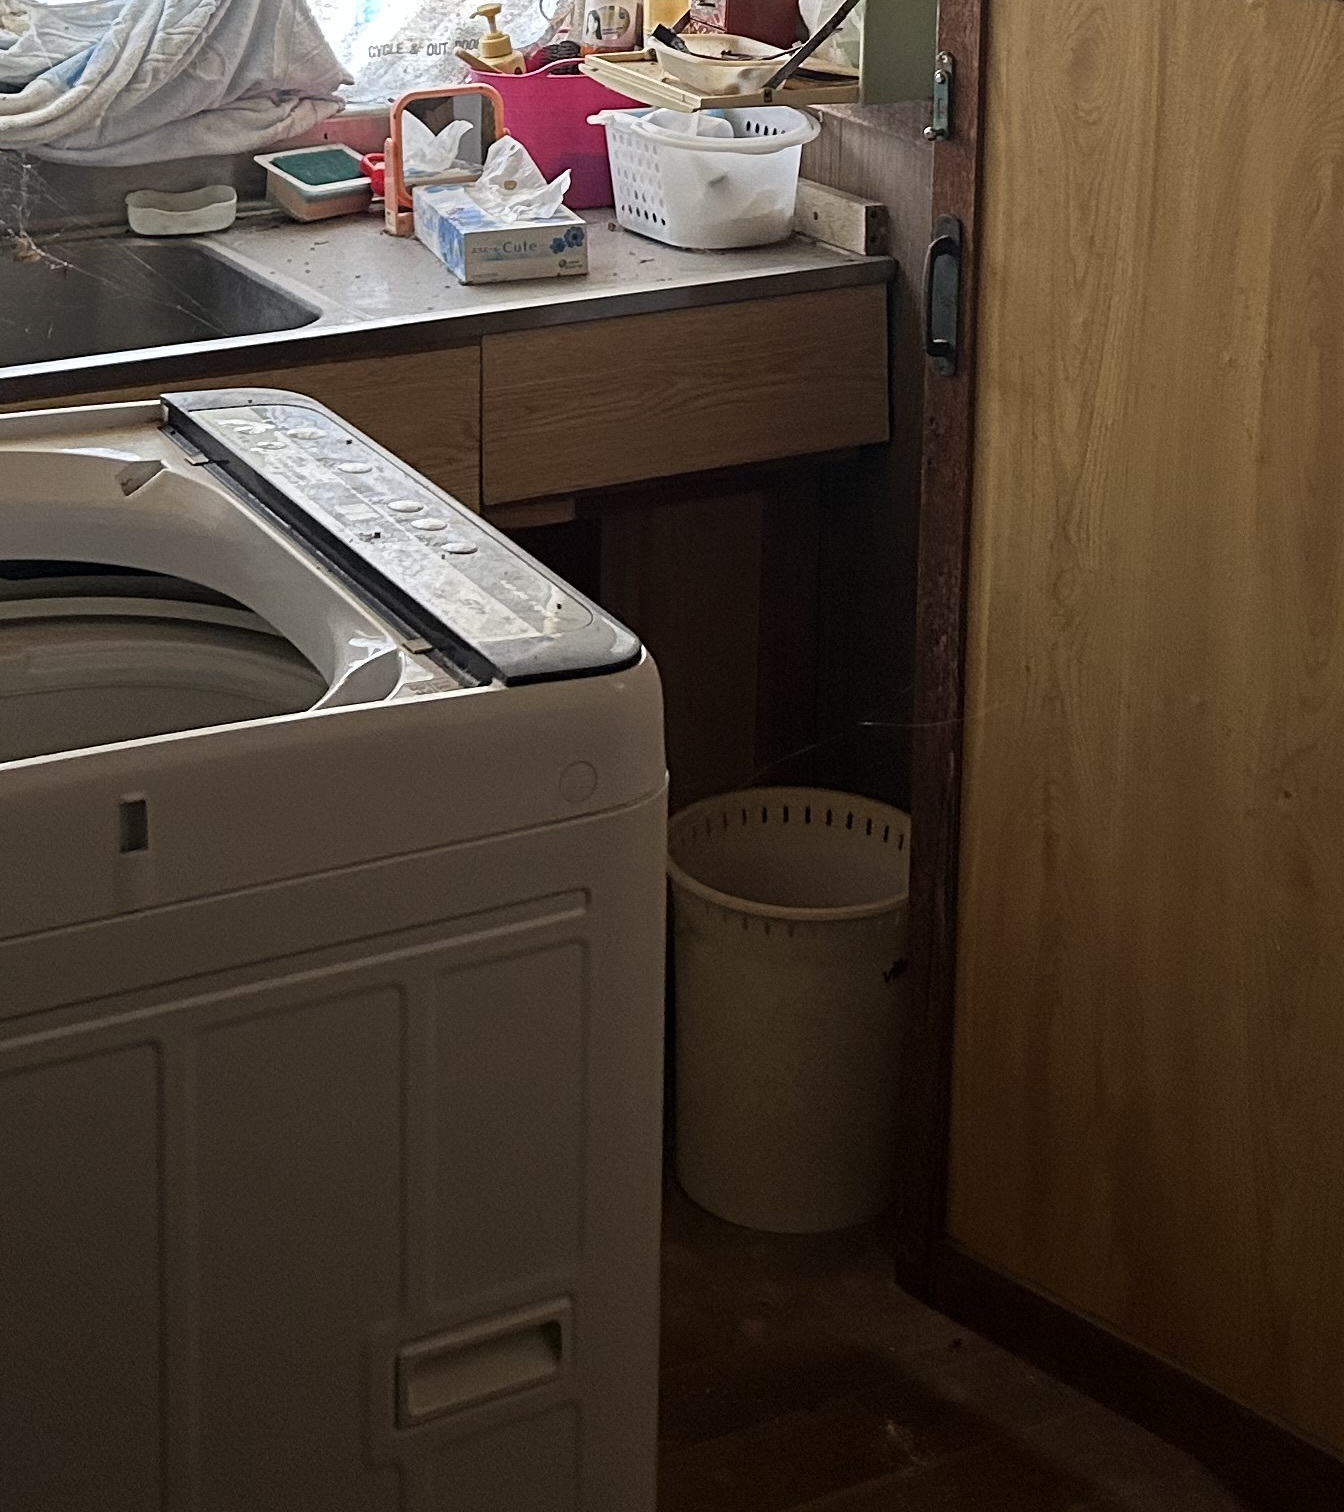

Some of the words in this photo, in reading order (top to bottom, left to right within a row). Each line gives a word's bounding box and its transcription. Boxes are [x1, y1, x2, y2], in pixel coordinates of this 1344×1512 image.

[368, 41, 405, 59] CYCLE
[426, 41, 449, 57] OUT
[502, 240, 538, 254] Cute
